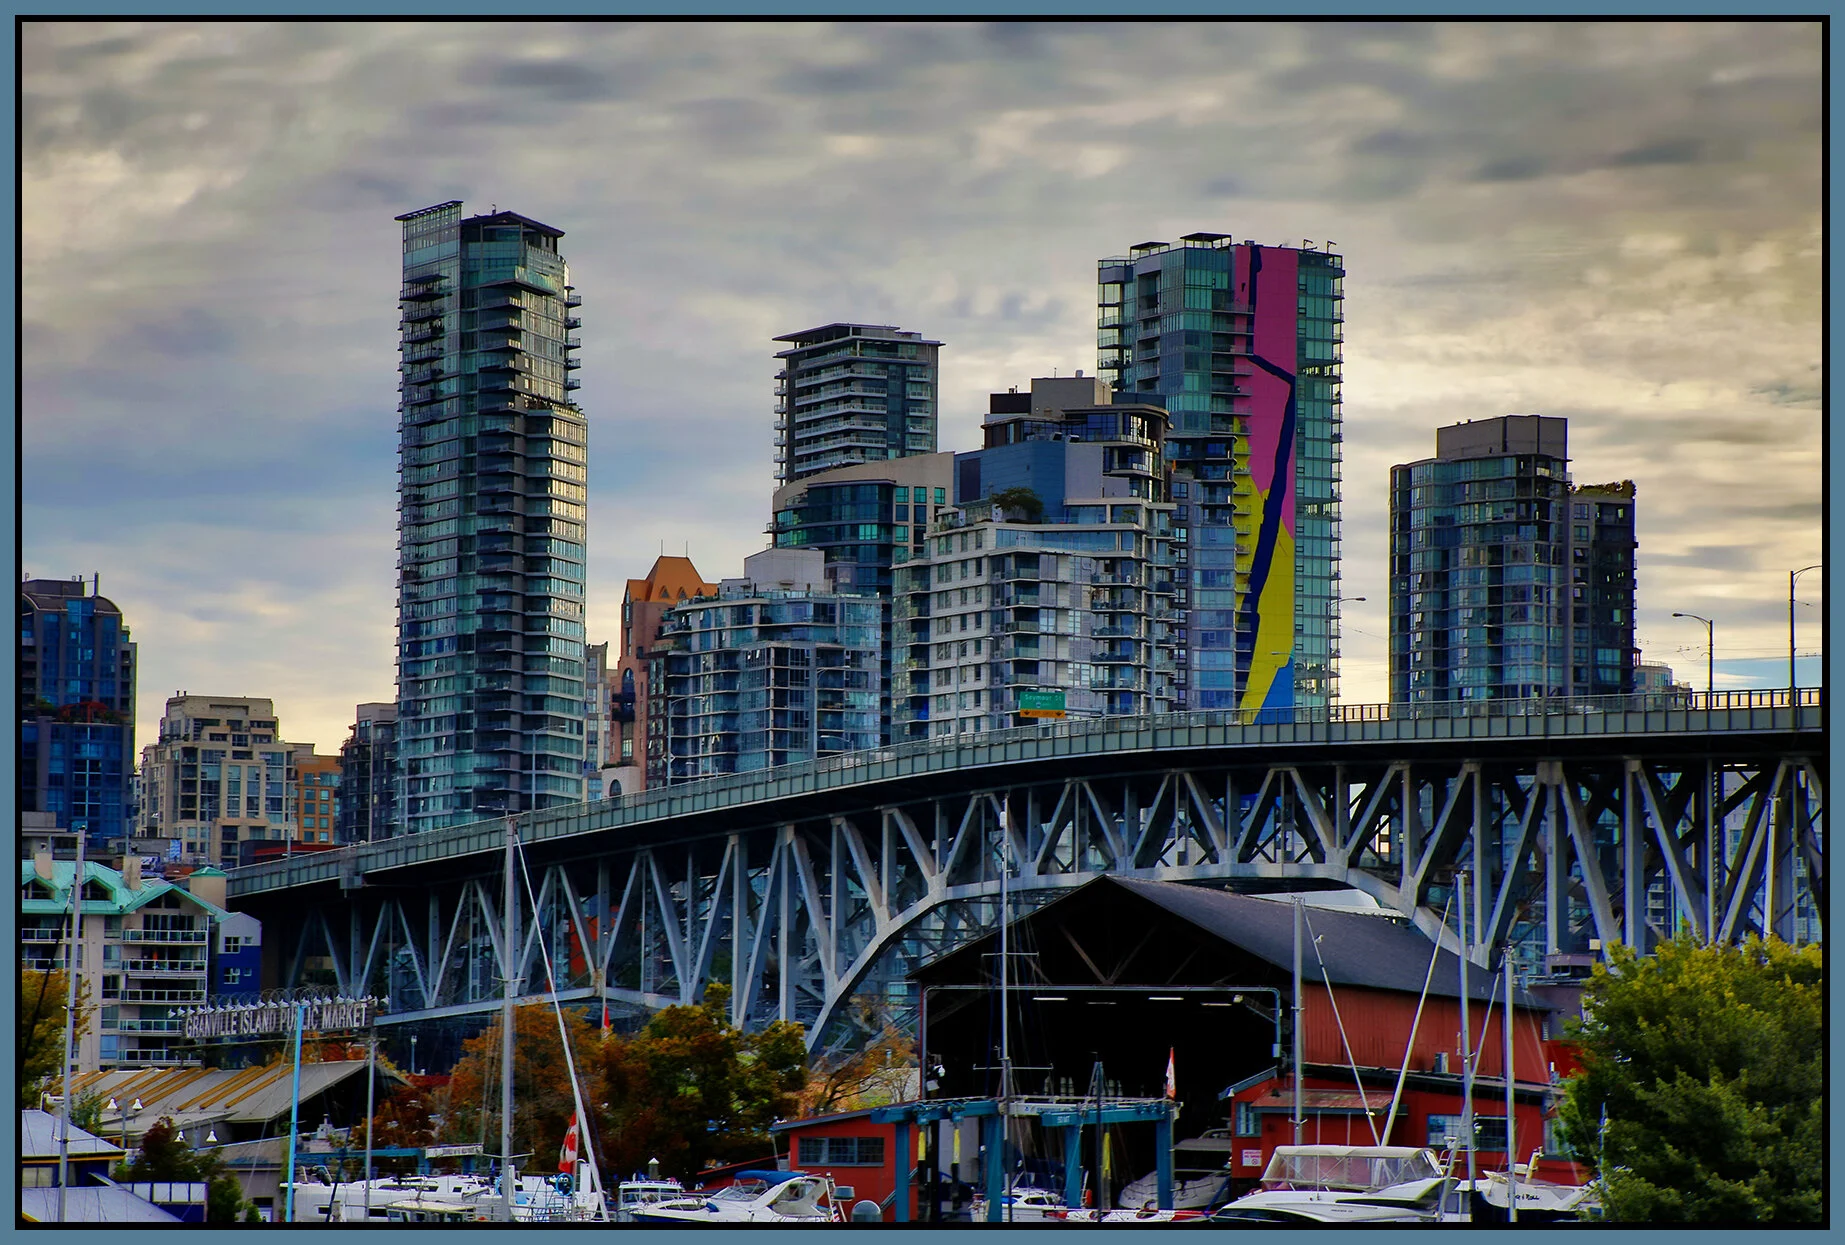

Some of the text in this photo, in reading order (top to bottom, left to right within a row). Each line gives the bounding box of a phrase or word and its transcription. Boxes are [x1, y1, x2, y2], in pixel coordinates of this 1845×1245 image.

[1025, 693, 1052, 701] Seymour
[186, 1011, 237, 1038] GRANVILLE
[240, 1009, 277, 1033] ISLAND
[322, 1002, 368, 1028] MARKET
